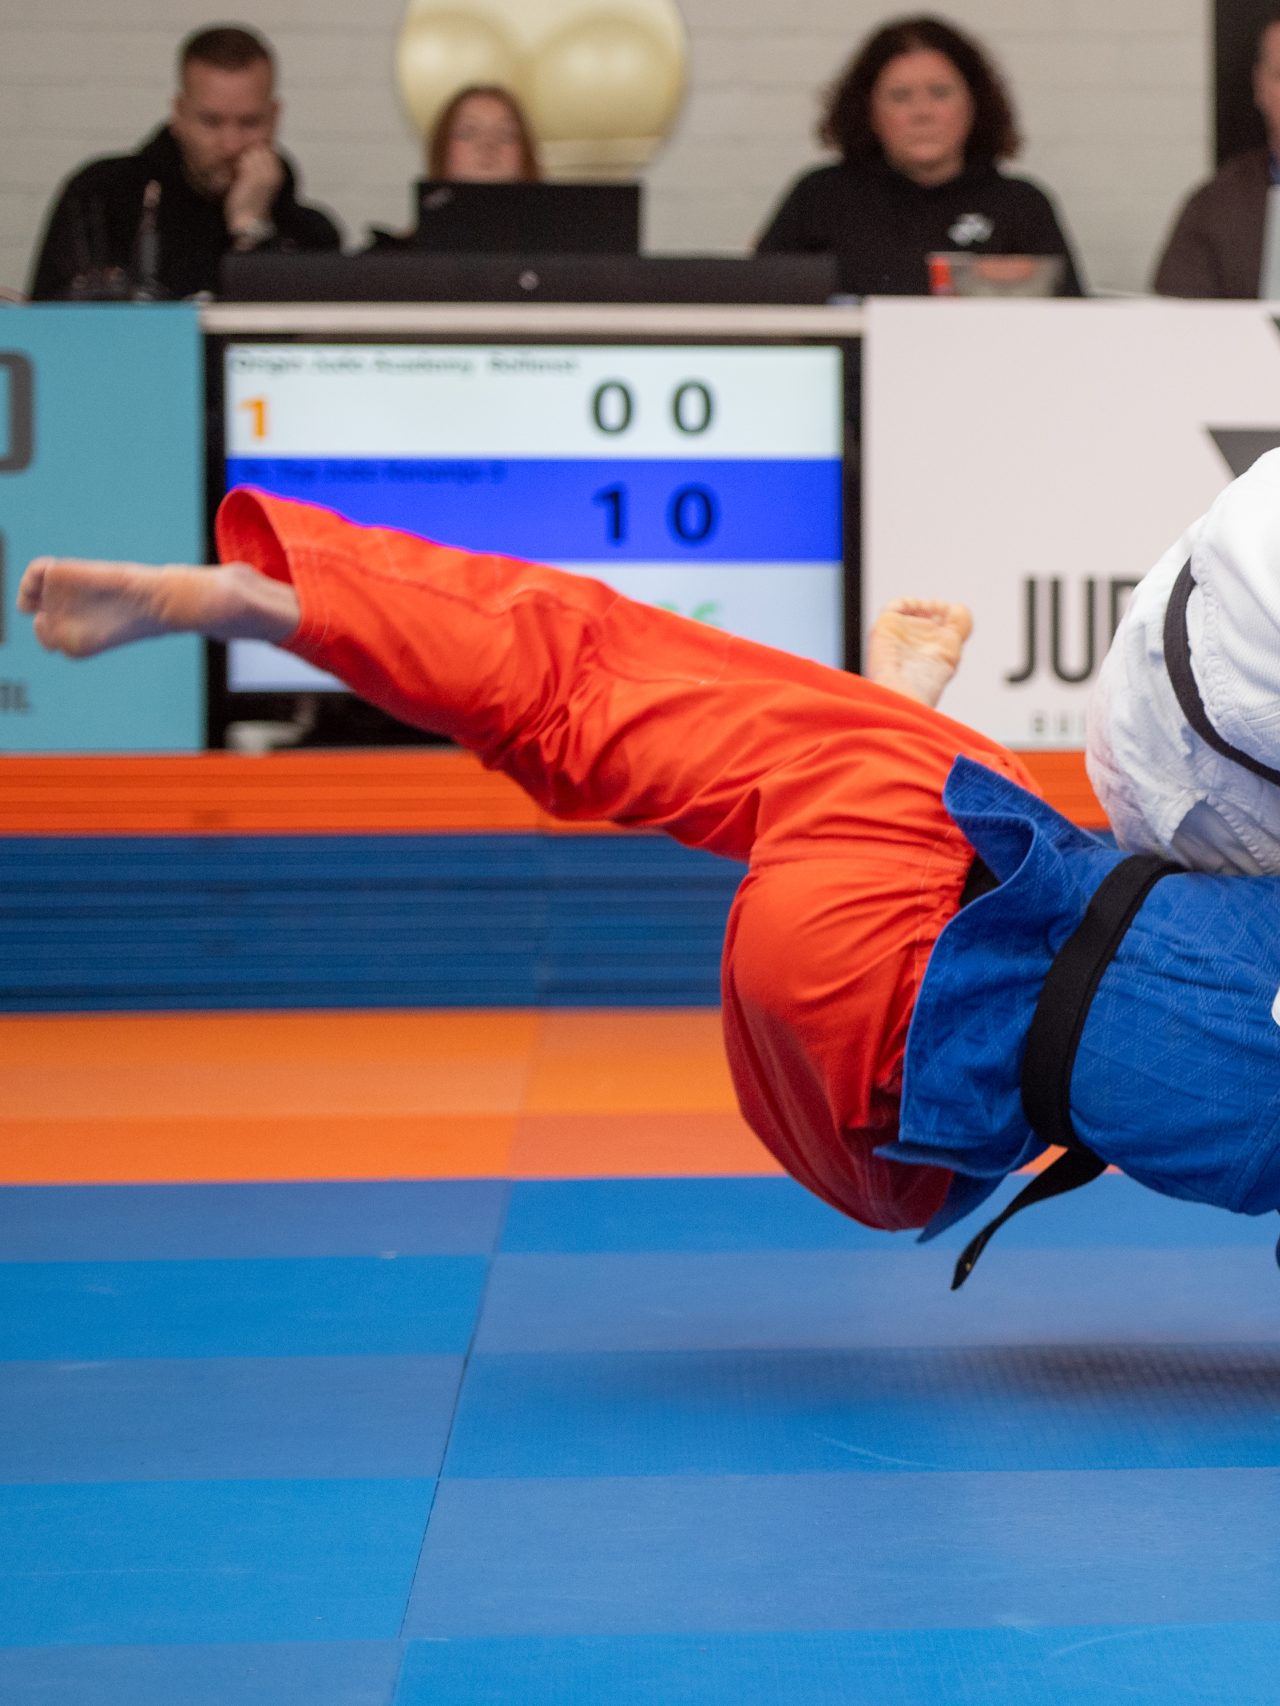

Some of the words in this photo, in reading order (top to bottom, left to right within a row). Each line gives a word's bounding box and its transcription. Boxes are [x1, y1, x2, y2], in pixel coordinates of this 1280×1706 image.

[238, 396, 268, 440] 1
[592, 378, 634, 437] 0
[672, 378, 714, 437] 0
[595, 485, 623, 543] 1
[671, 484, 714, 544] 0
